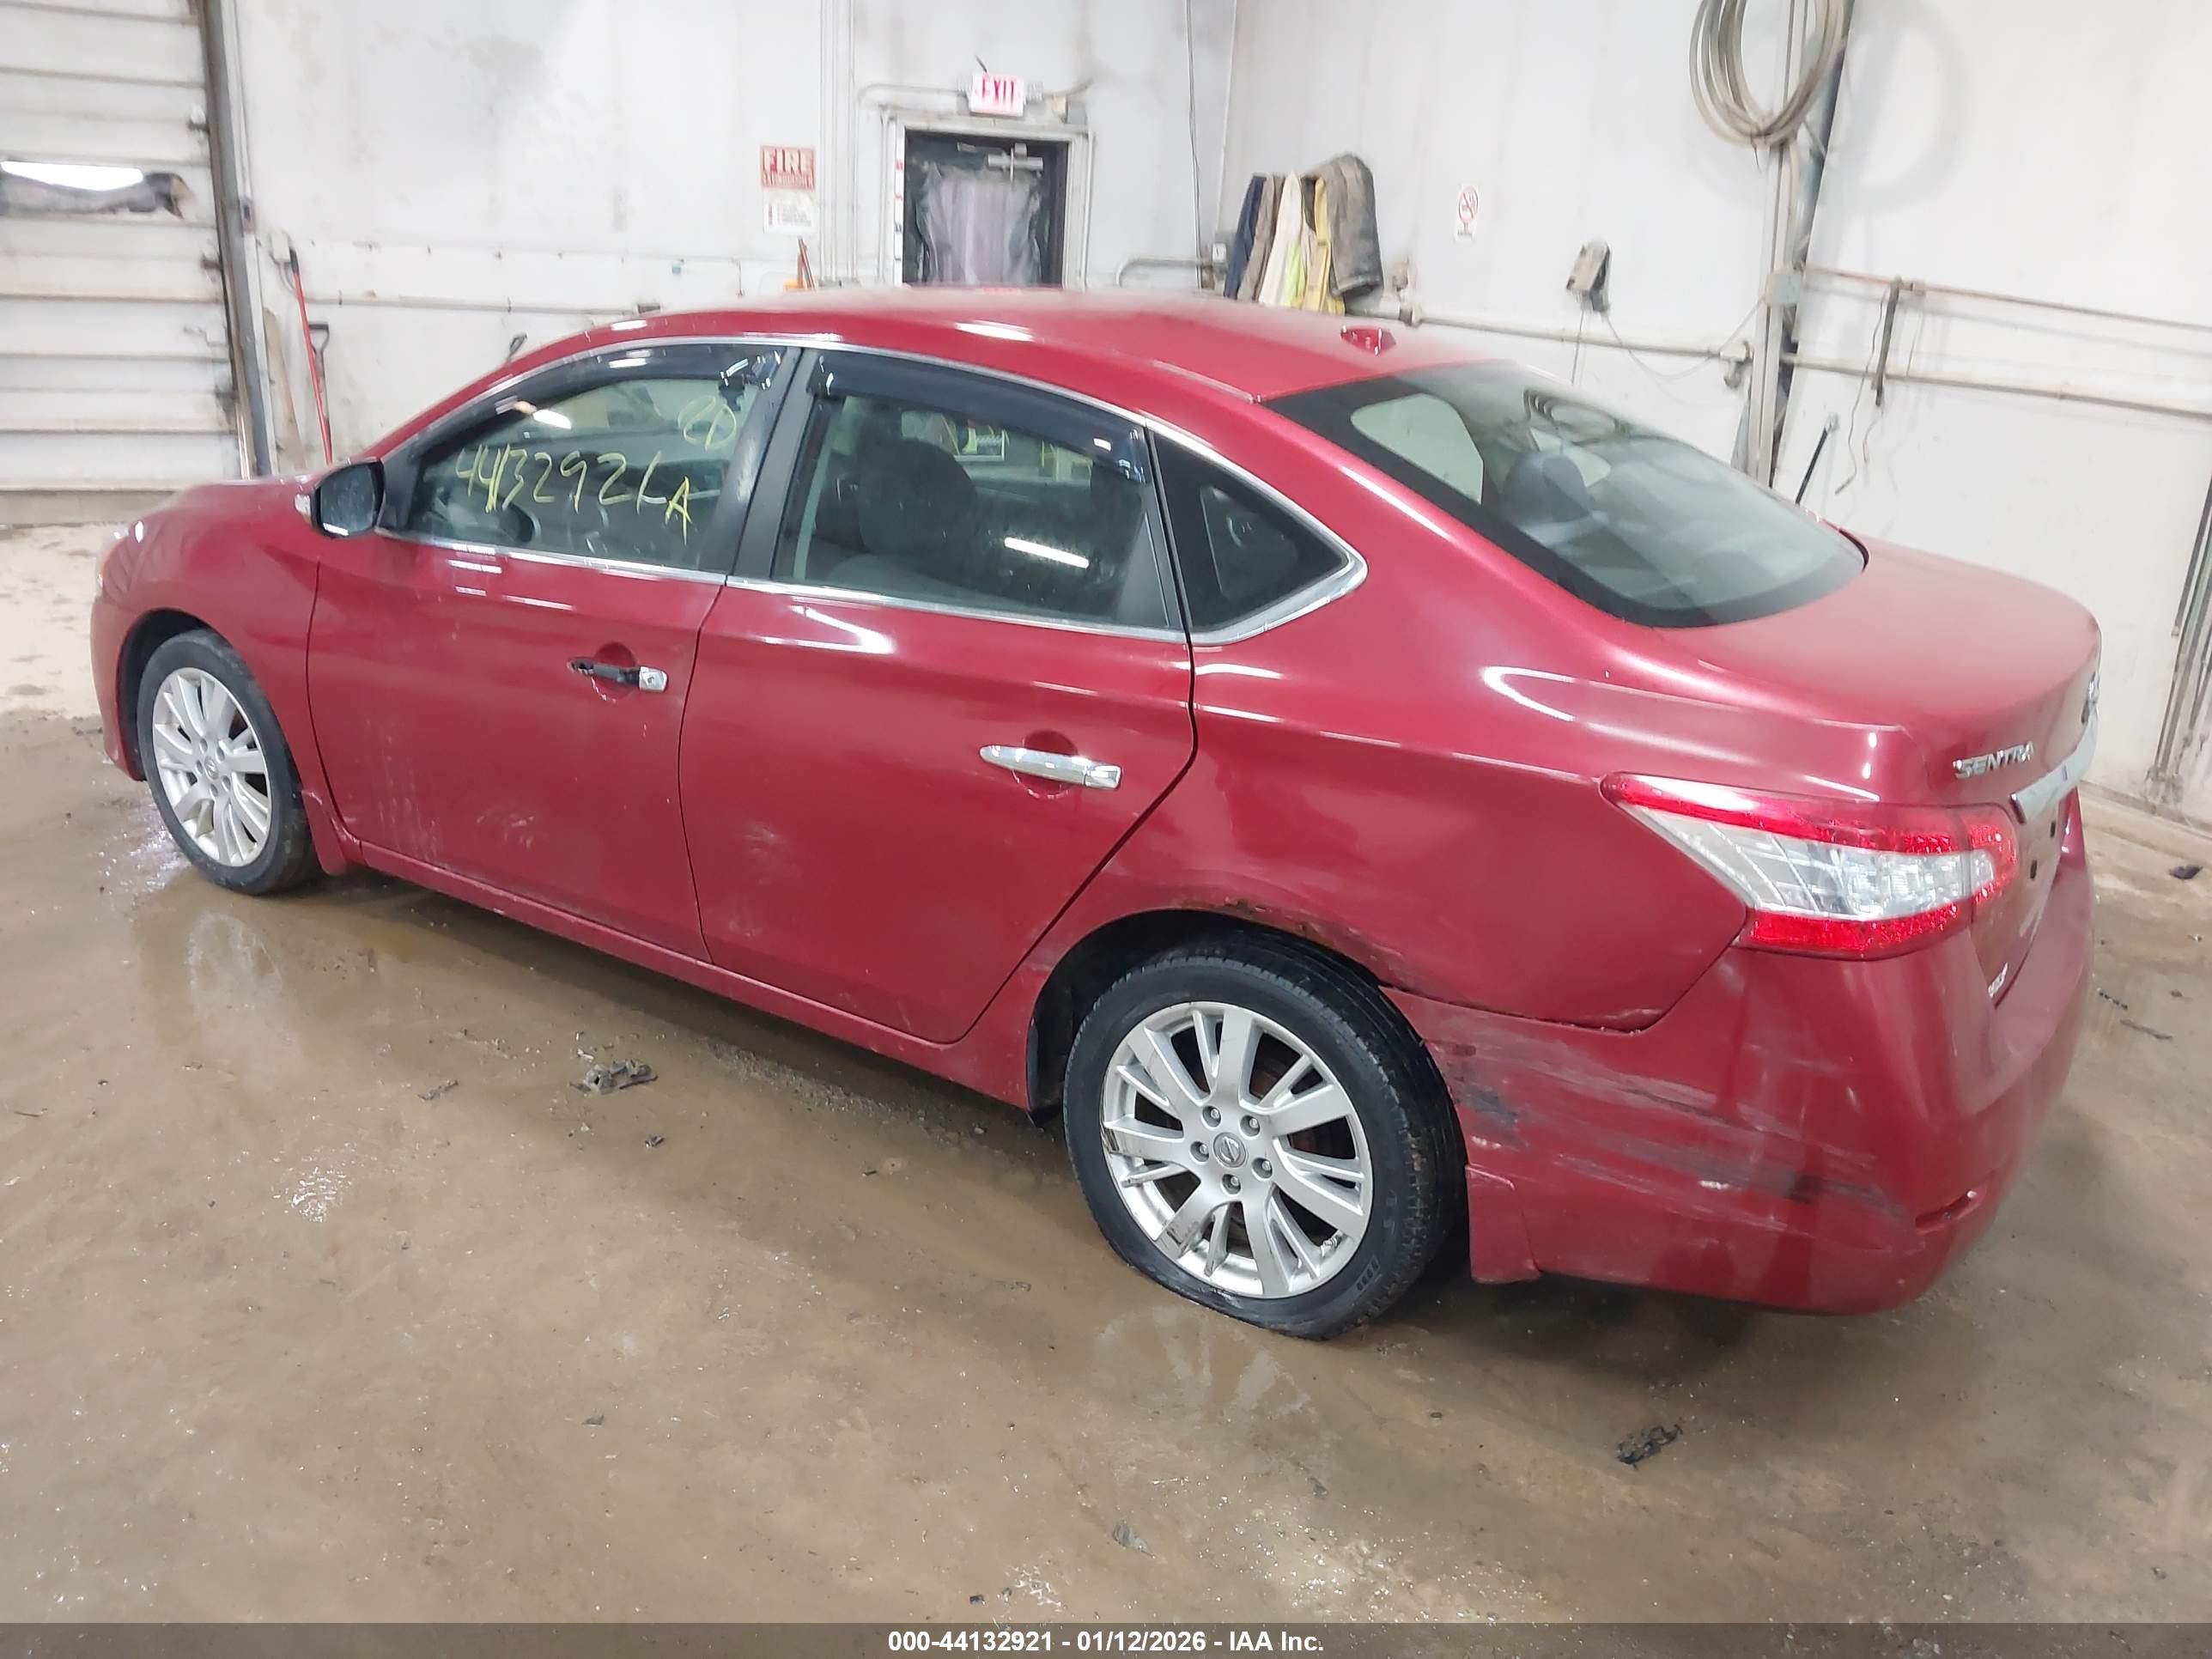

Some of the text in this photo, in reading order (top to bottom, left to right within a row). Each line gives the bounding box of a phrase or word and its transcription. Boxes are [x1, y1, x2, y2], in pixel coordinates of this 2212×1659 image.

[981, 75, 1018, 107] EXIT
[763, 148, 814, 174] FIRE
[1952, 741, 2035, 780] SENTRA
